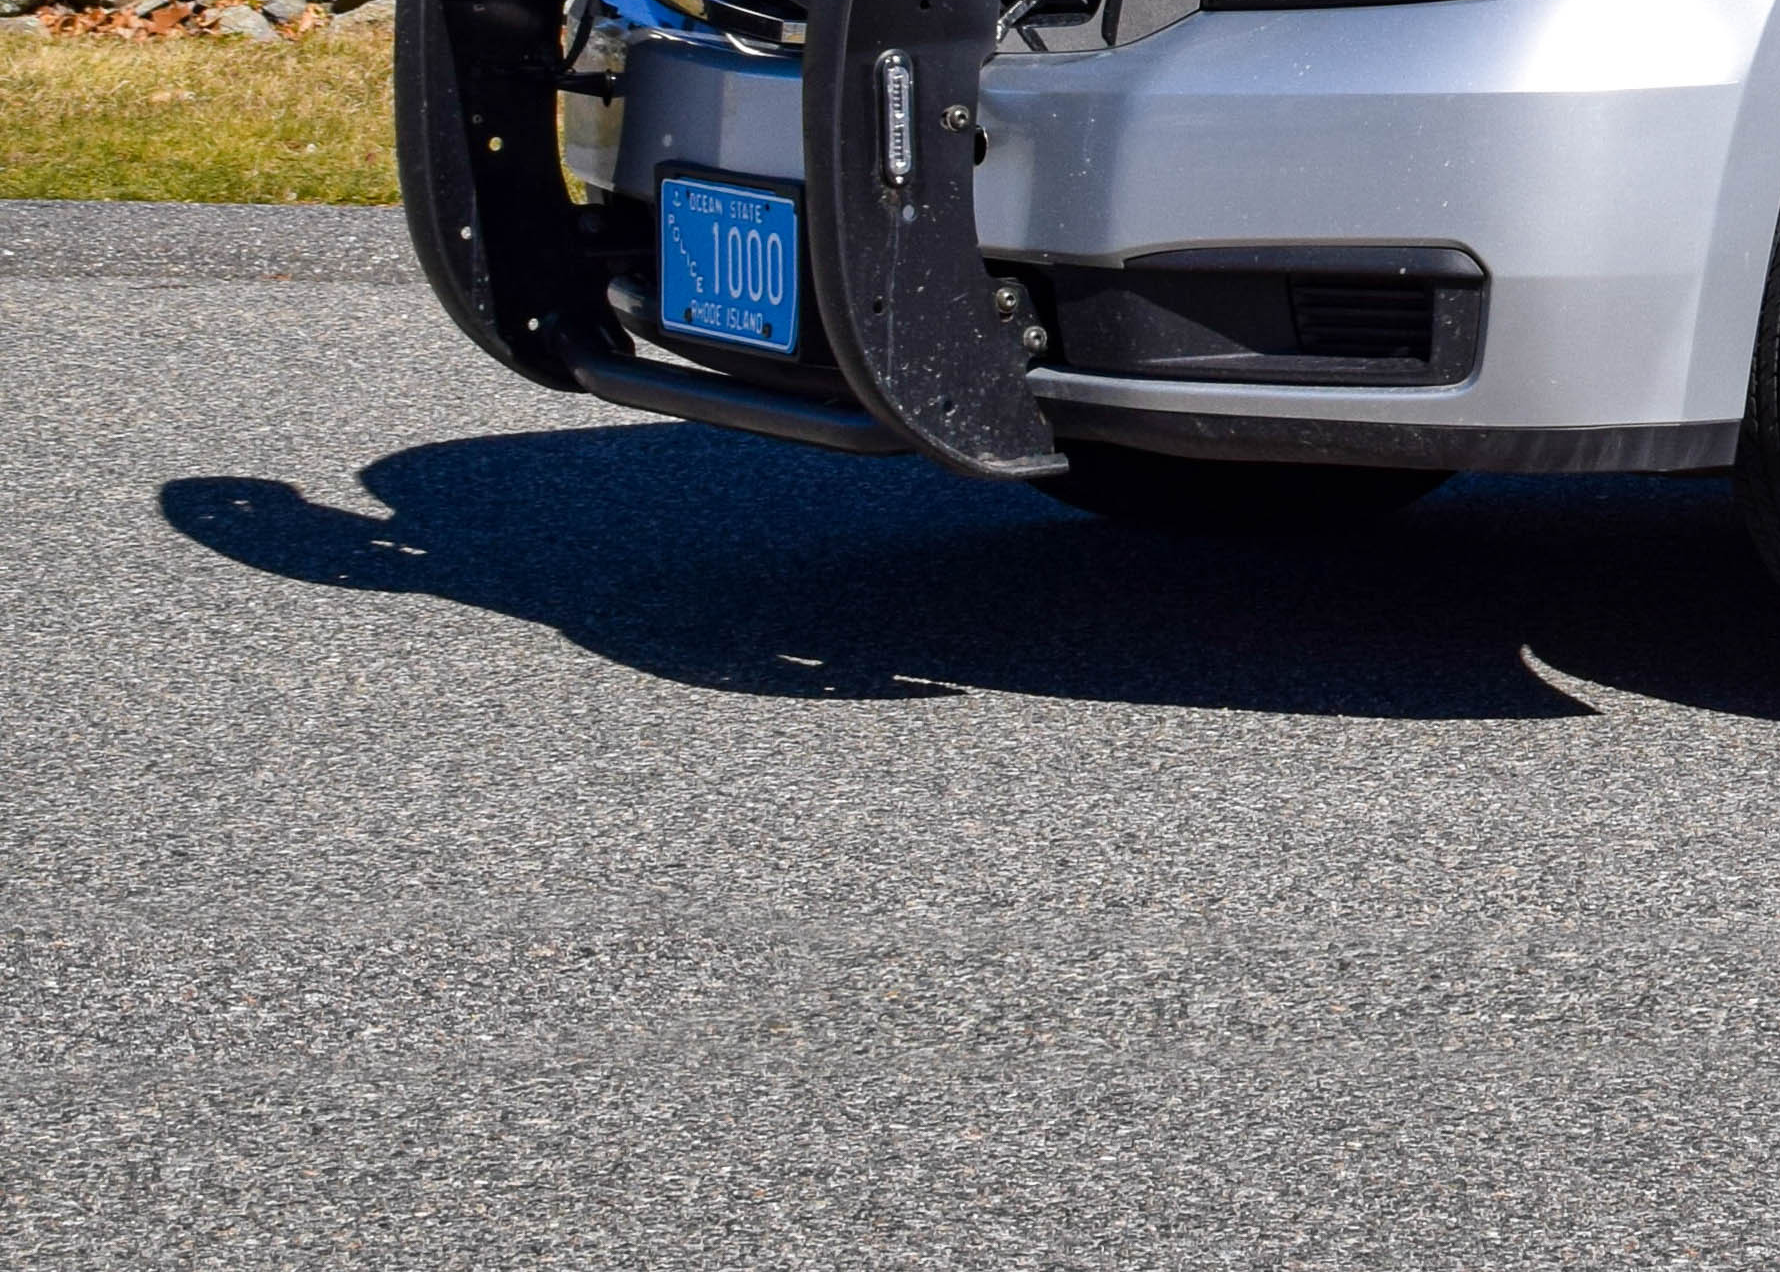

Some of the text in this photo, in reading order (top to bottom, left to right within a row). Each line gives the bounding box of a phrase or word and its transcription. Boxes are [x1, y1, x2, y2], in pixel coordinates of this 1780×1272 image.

[689, 192, 763, 224] OCEAN STATE
[667, 214, 704, 293] POLICE
[712, 221, 783, 306] 1000
[690, 299, 764, 335] RHODE ISLAND
